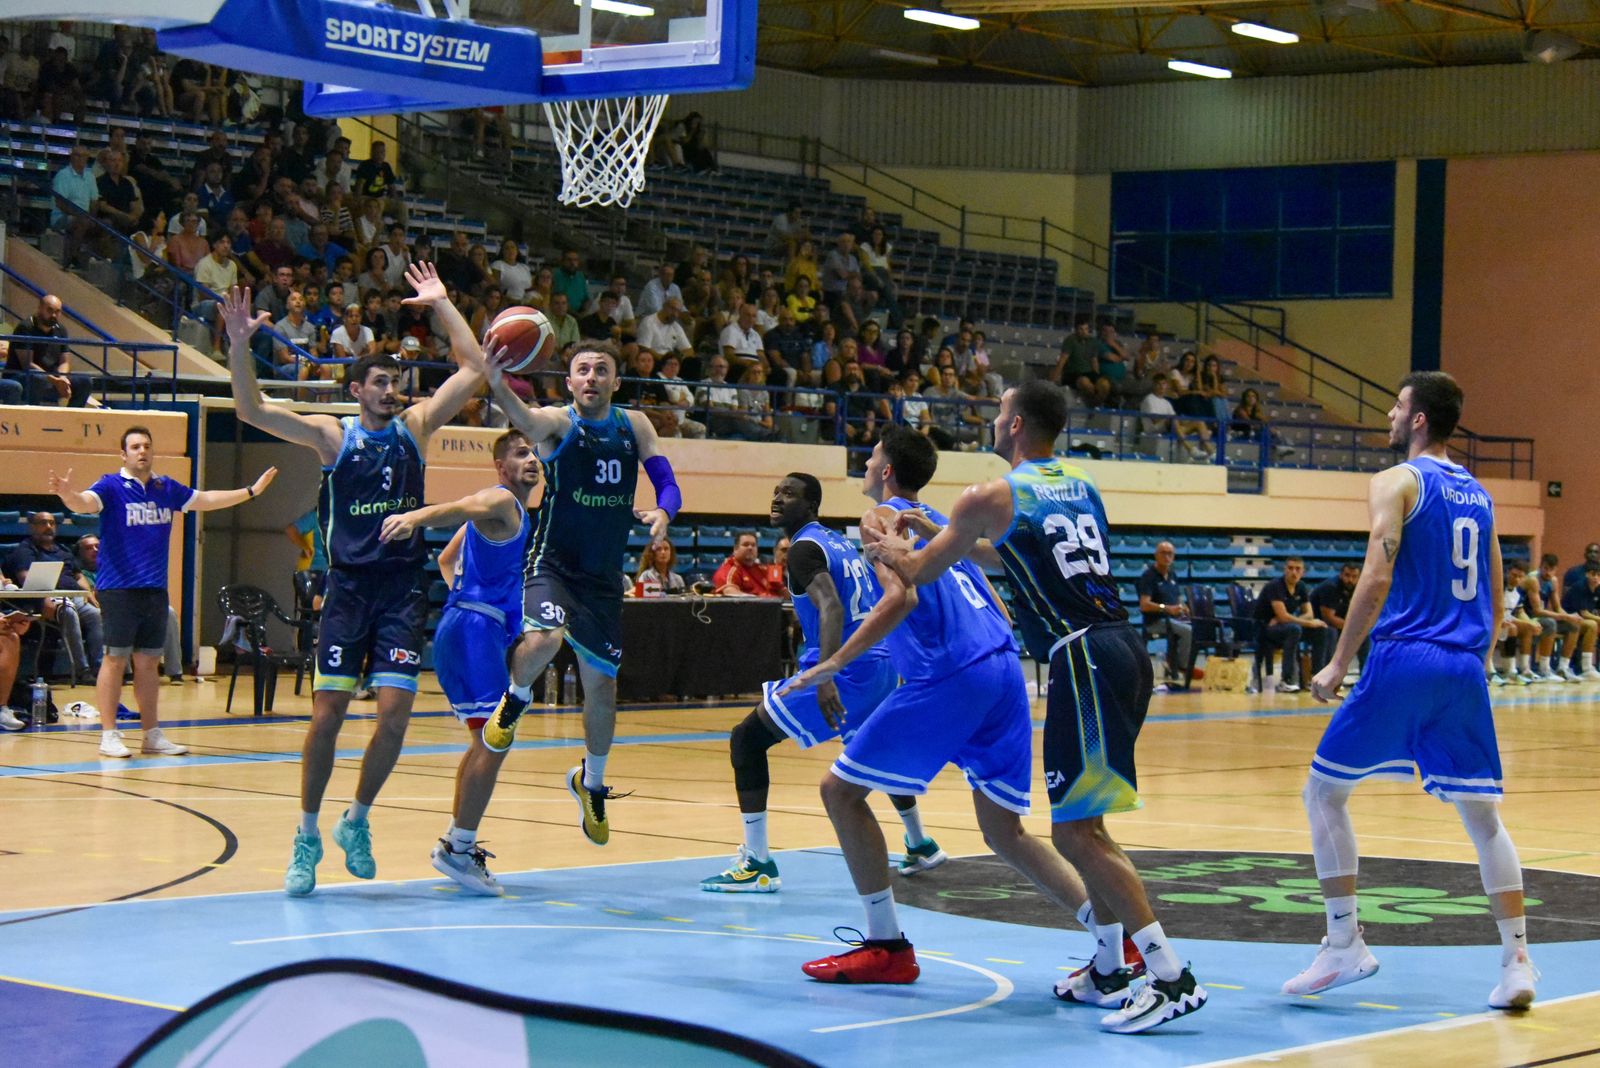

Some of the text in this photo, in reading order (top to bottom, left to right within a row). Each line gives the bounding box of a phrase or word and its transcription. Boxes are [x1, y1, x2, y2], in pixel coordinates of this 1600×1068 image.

[325, 18, 491, 64] SPORT SYSTEM
[82, 423, 105, 438] TV
[381, 465, 394, 492] 3
[594, 458, 622, 484] 30
[350, 496, 417, 516] damex.io
[1440, 485, 1490, 510] URDIAIN
[126, 507, 172, 527] HUELVA
[1042, 513, 1110, 580] 29
[1451, 516, 1479, 601] 9
[540, 601, 566, 625] 30
[328, 644, 343, 668] 3
